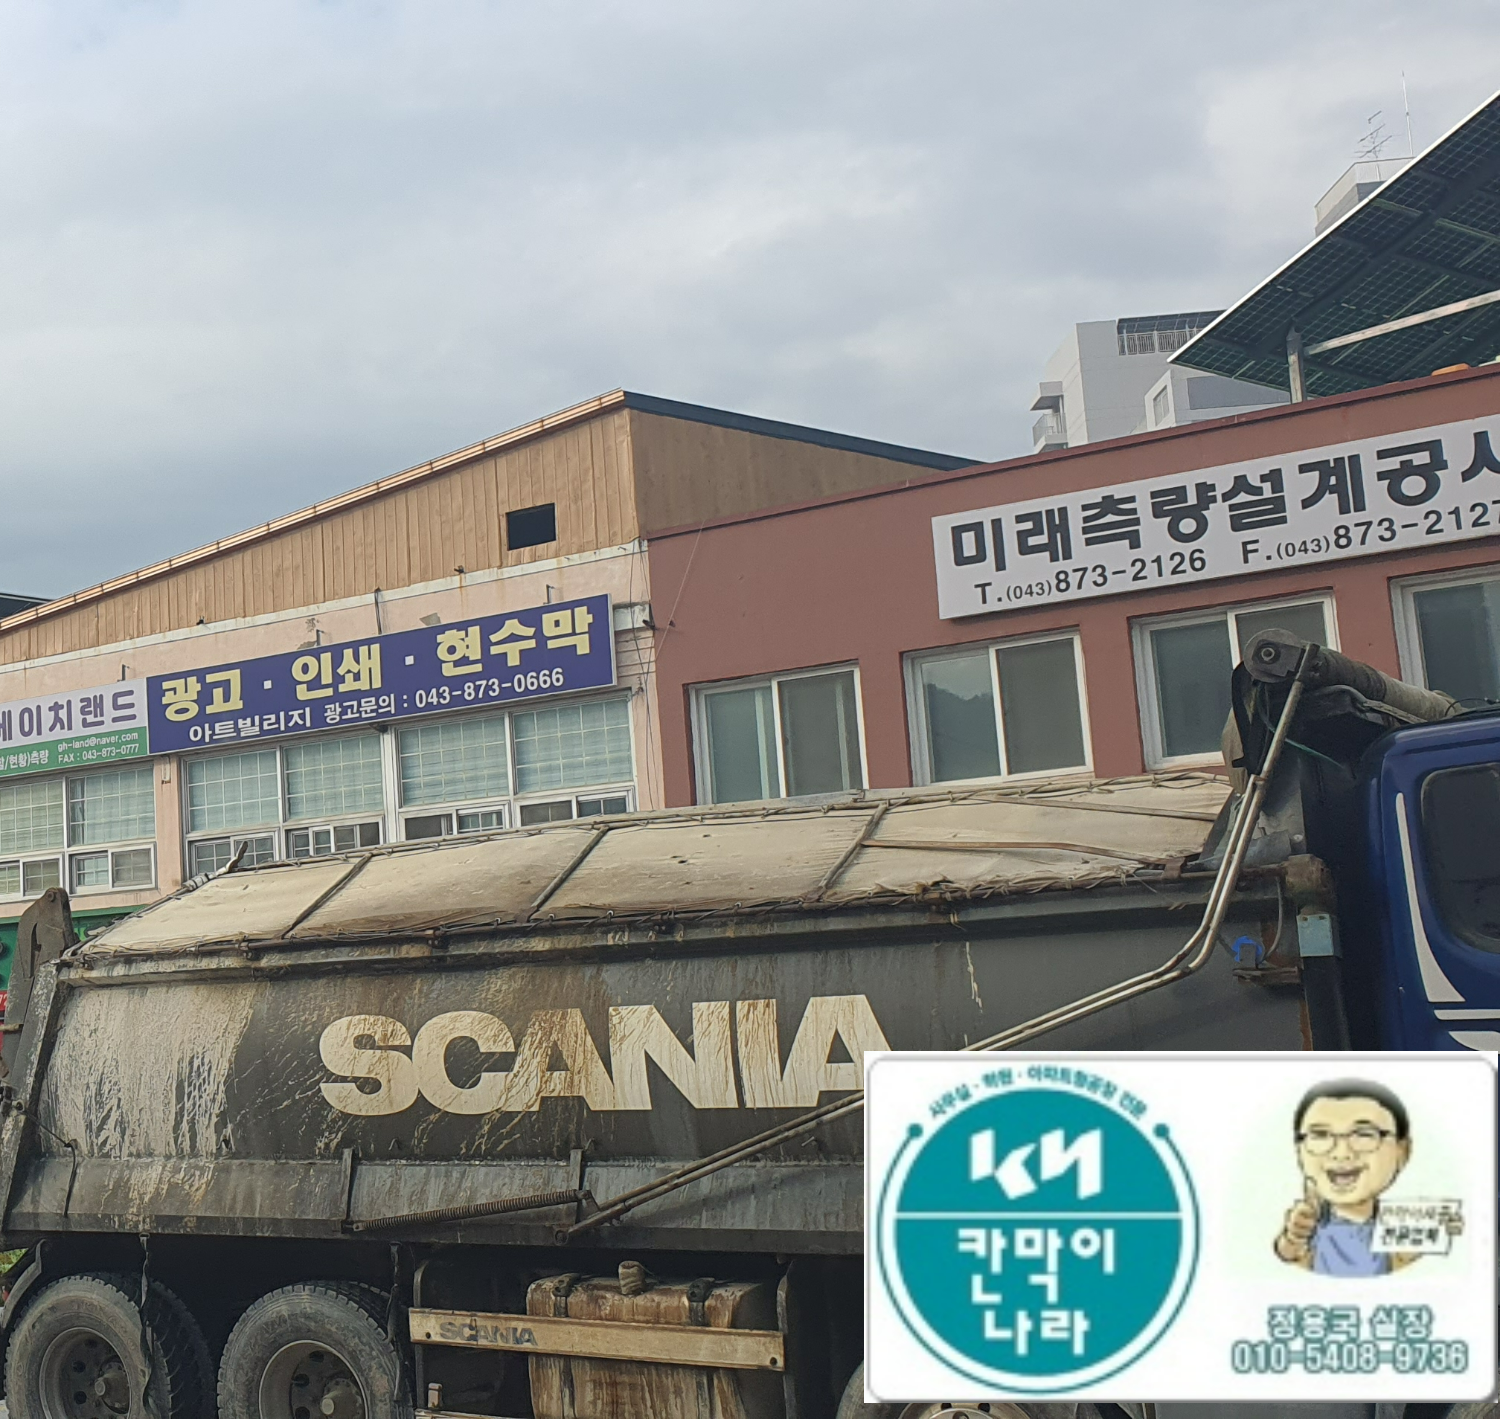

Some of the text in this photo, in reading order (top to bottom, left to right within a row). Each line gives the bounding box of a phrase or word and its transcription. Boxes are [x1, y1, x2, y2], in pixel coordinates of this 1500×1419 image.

[974, 548, 1208, 606] T.(043)873-2126
[161, 605, 594, 723] 광고 인쇄 현수막
[188, 666, 565, 744] 아트빌리지 광고문의 043-873-0666
[57, 731, 139, 752] gh-land@naver.com
[58, 743, 140, 764] FAX 043-873-0777
[319, 994, 893, 1117] SCANIA
[438, 1320, 539, 1347] SCANIA
